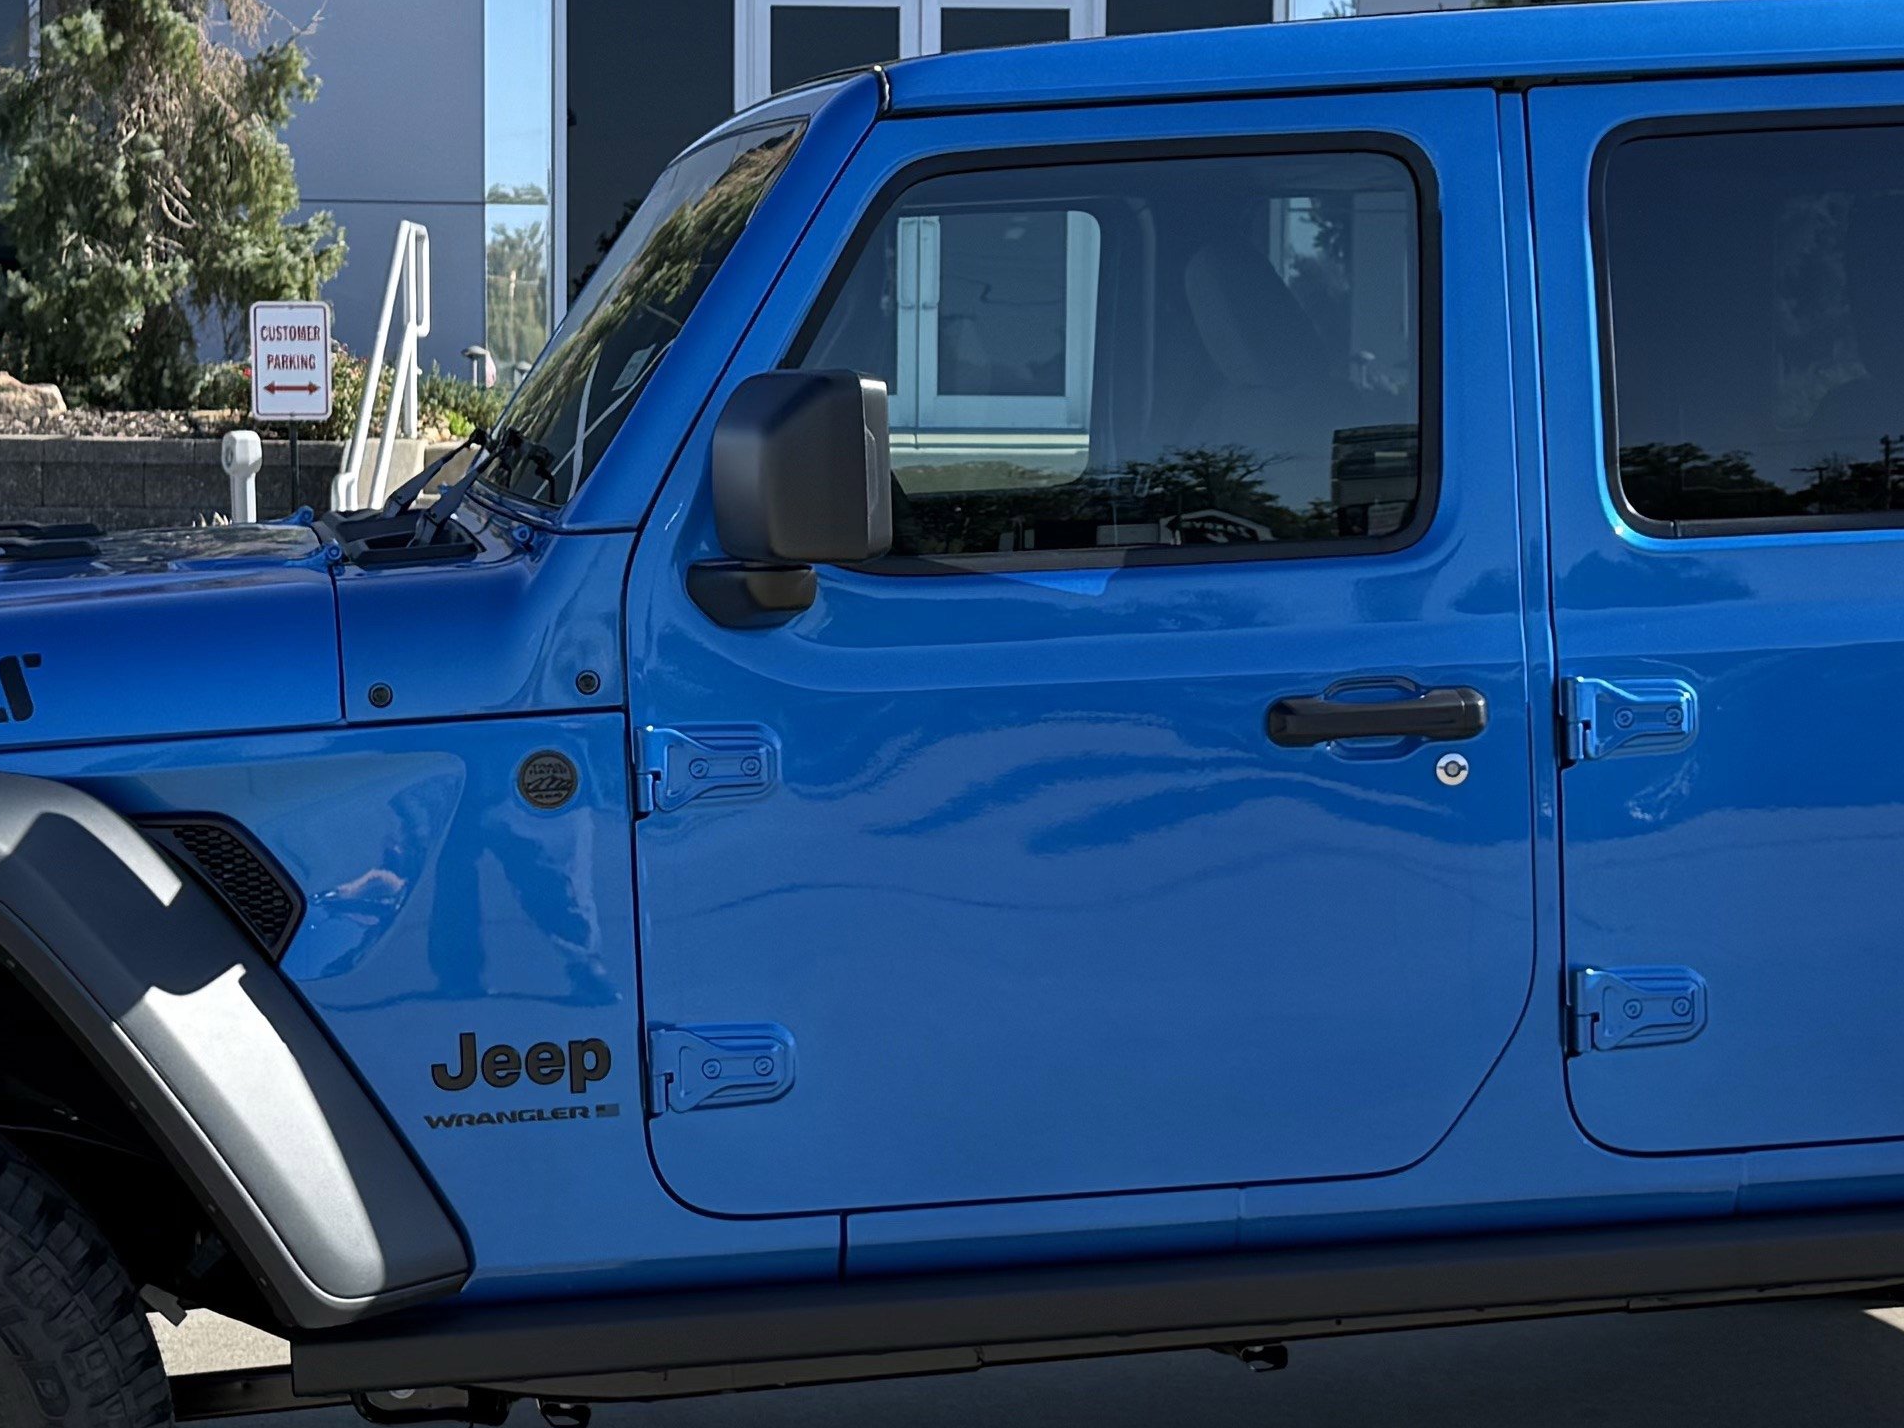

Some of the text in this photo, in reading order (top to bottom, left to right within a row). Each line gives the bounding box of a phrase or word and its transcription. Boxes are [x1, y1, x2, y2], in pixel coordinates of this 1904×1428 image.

[260, 324, 321, 342] CUSTOMER
[266, 353, 317, 370] PARKING
[430, 1031, 612, 1094] Jeep
[423, 1104, 591, 1130] WRANGLER
